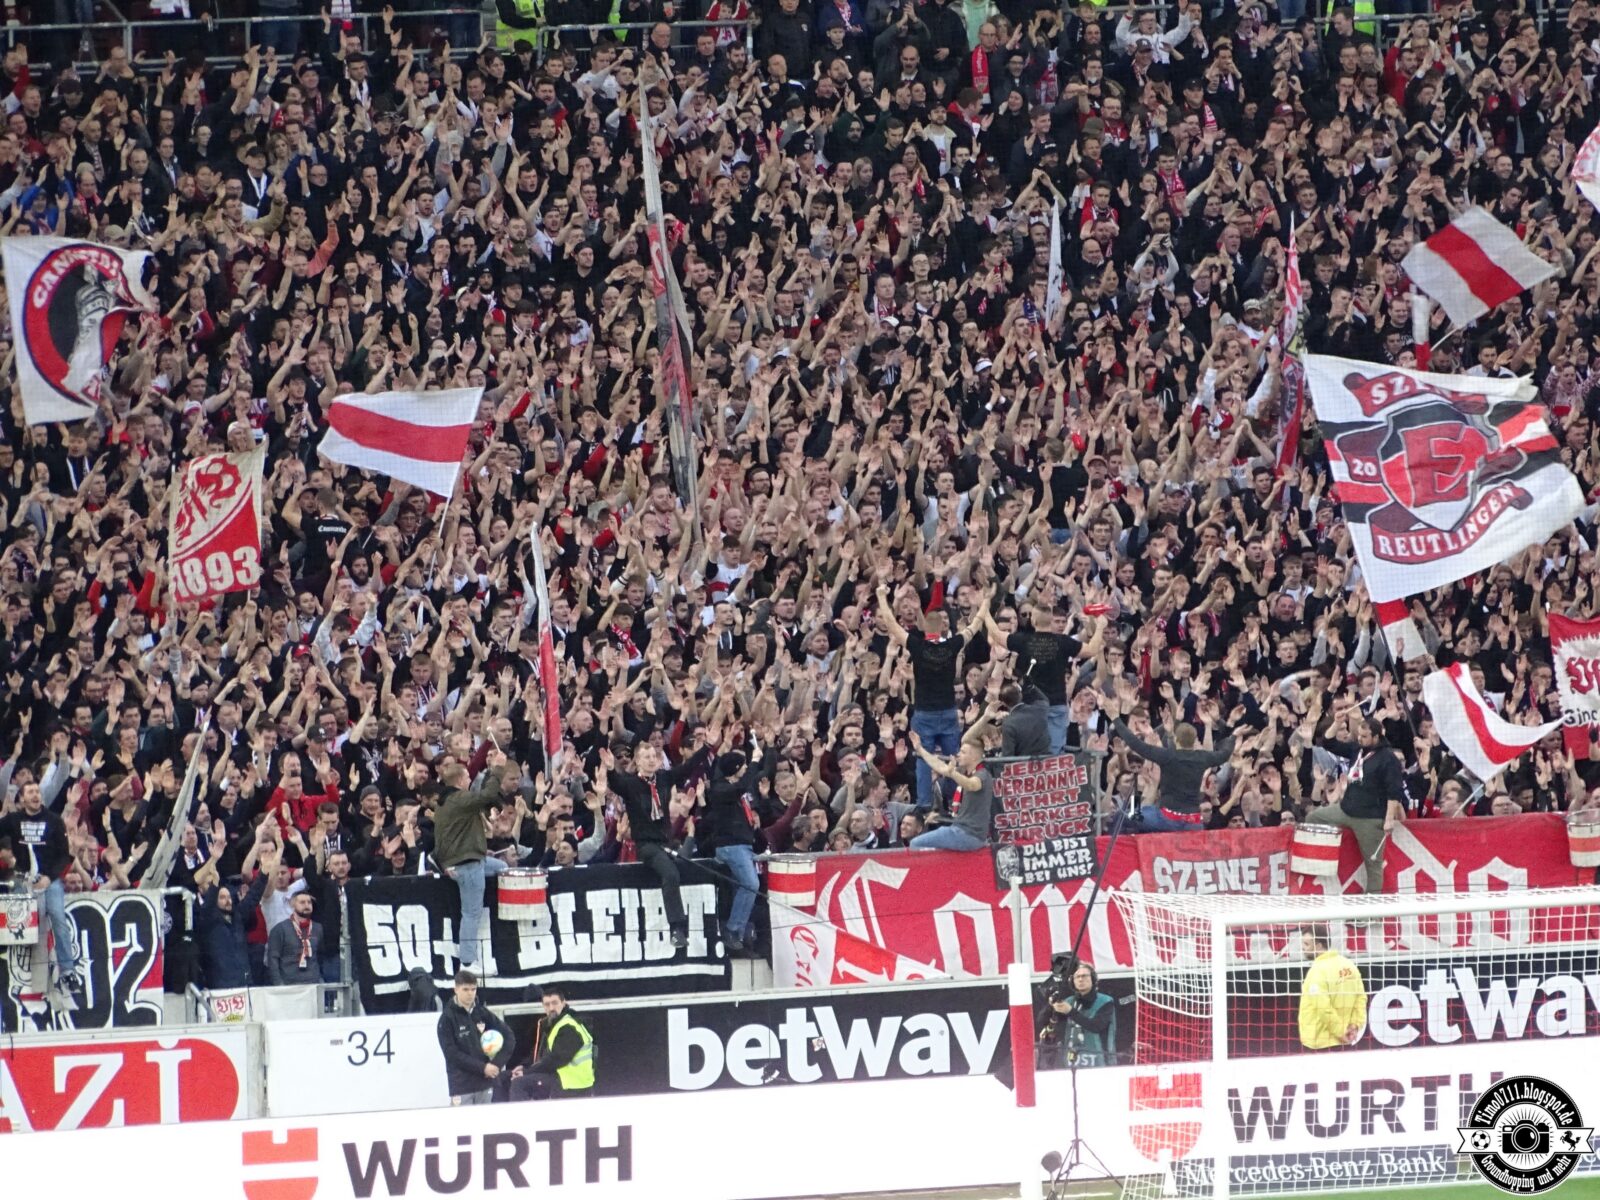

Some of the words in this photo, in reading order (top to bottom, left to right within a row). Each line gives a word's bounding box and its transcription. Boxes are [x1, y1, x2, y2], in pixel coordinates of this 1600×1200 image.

[1352, 458, 1378, 477] 20
[1377, 483, 1516, 557] REUTLINGEN
[172, 546, 260, 598] 1893
[993, 765, 1088, 797] VERBANNTE
[1001, 754, 1075, 778] JEDER
[1002, 787, 1081, 812] KEHRT
[1023, 842, 1047, 856] DU
[1052, 836, 1088, 852] BIST
[1023, 848, 1091, 871] IMMER
[1024, 870, 1050, 884] BEI
[1057, 863, 1094, 879] UNS!
[1153, 856, 1262, 895] SZENE
[1352, 966, 1600, 1047] etwa
[347, 1028, 396, 1067] 34
[667, 1005, 1009, 1091] betway
[341, 1124, 633, 1199] WÜRTH
[1184, 1156, 1372, 1186] Mcedes-Benz
[1382, 1150, 1447, 1175] Bank
